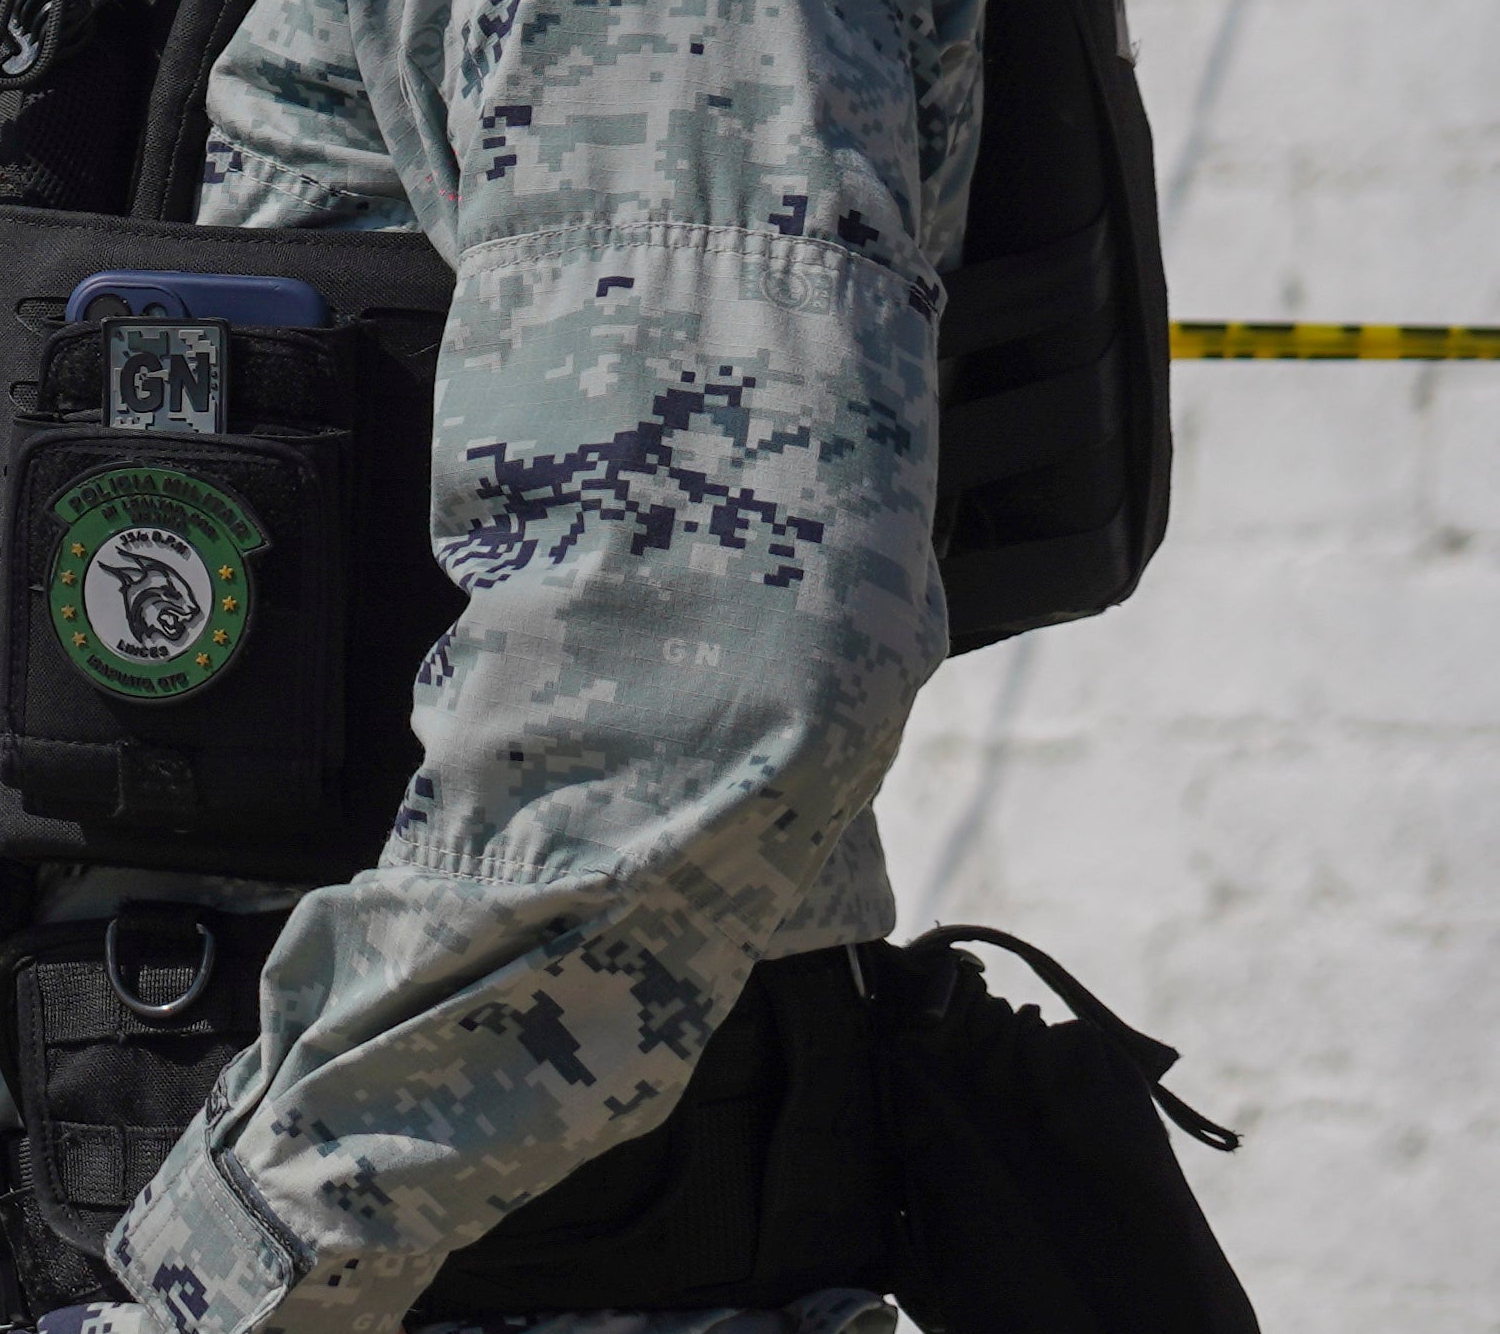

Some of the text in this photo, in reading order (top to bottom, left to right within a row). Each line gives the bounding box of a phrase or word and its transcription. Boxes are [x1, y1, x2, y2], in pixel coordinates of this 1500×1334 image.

[120, 351, 210, 415] GN
[67, 474, 157, 514] POLICIA
[116, 638, 169, 658] LINCES
[662, 639, 722, 667] GN
[353, 1312, 397, 1332] GN
